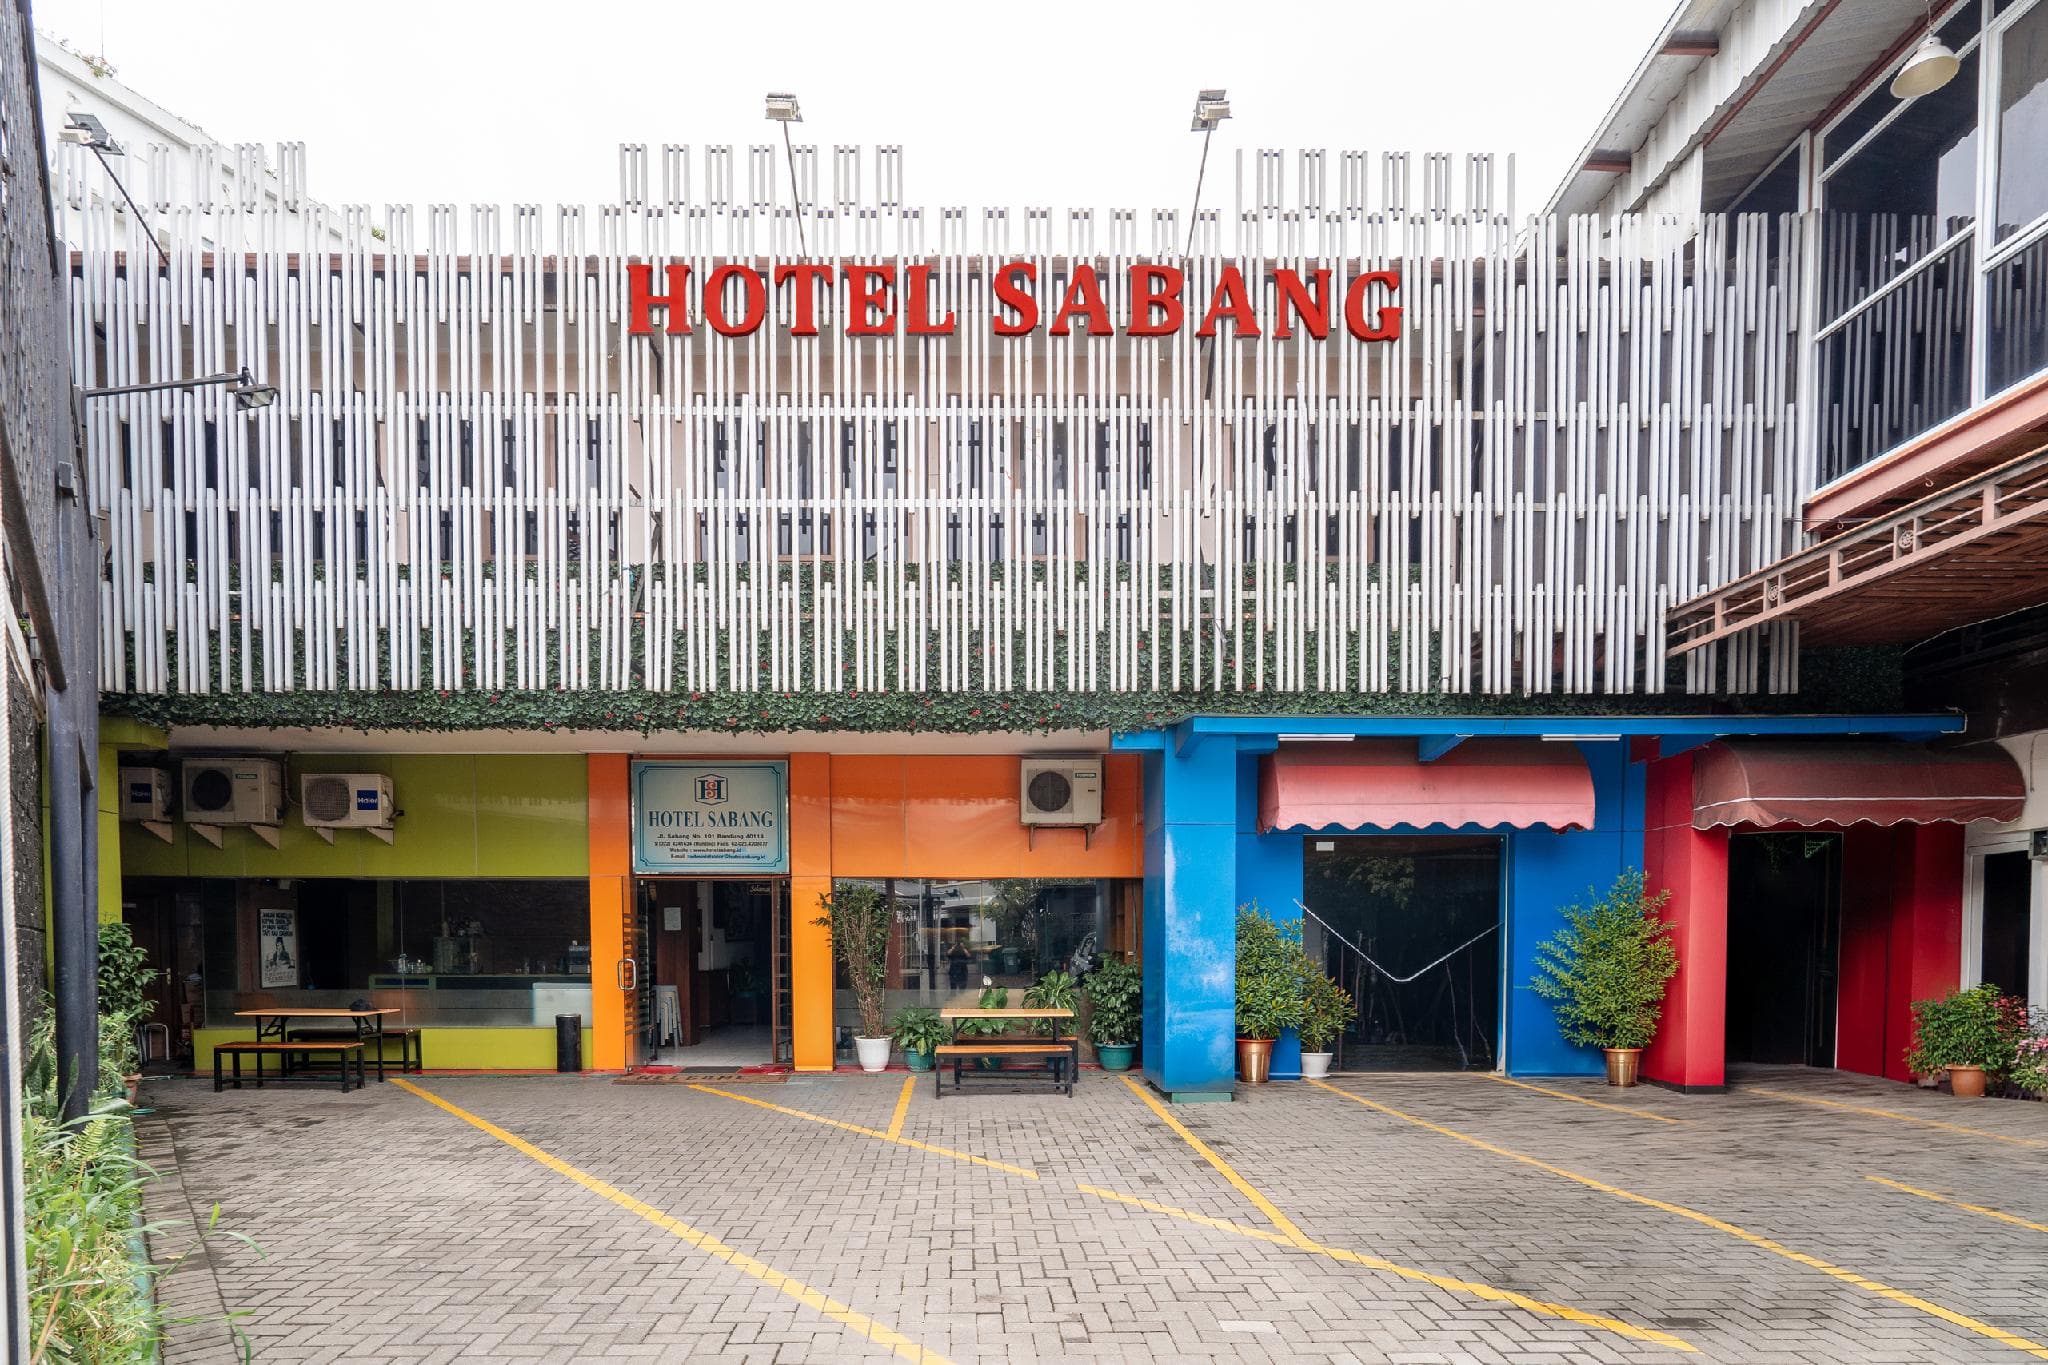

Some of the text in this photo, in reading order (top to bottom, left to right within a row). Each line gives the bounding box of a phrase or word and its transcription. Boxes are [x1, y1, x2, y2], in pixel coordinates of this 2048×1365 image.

[626, 263, 1404, 342] HOTEL SABANG
[649, 811, 773, 827] HOTEL SABANG
